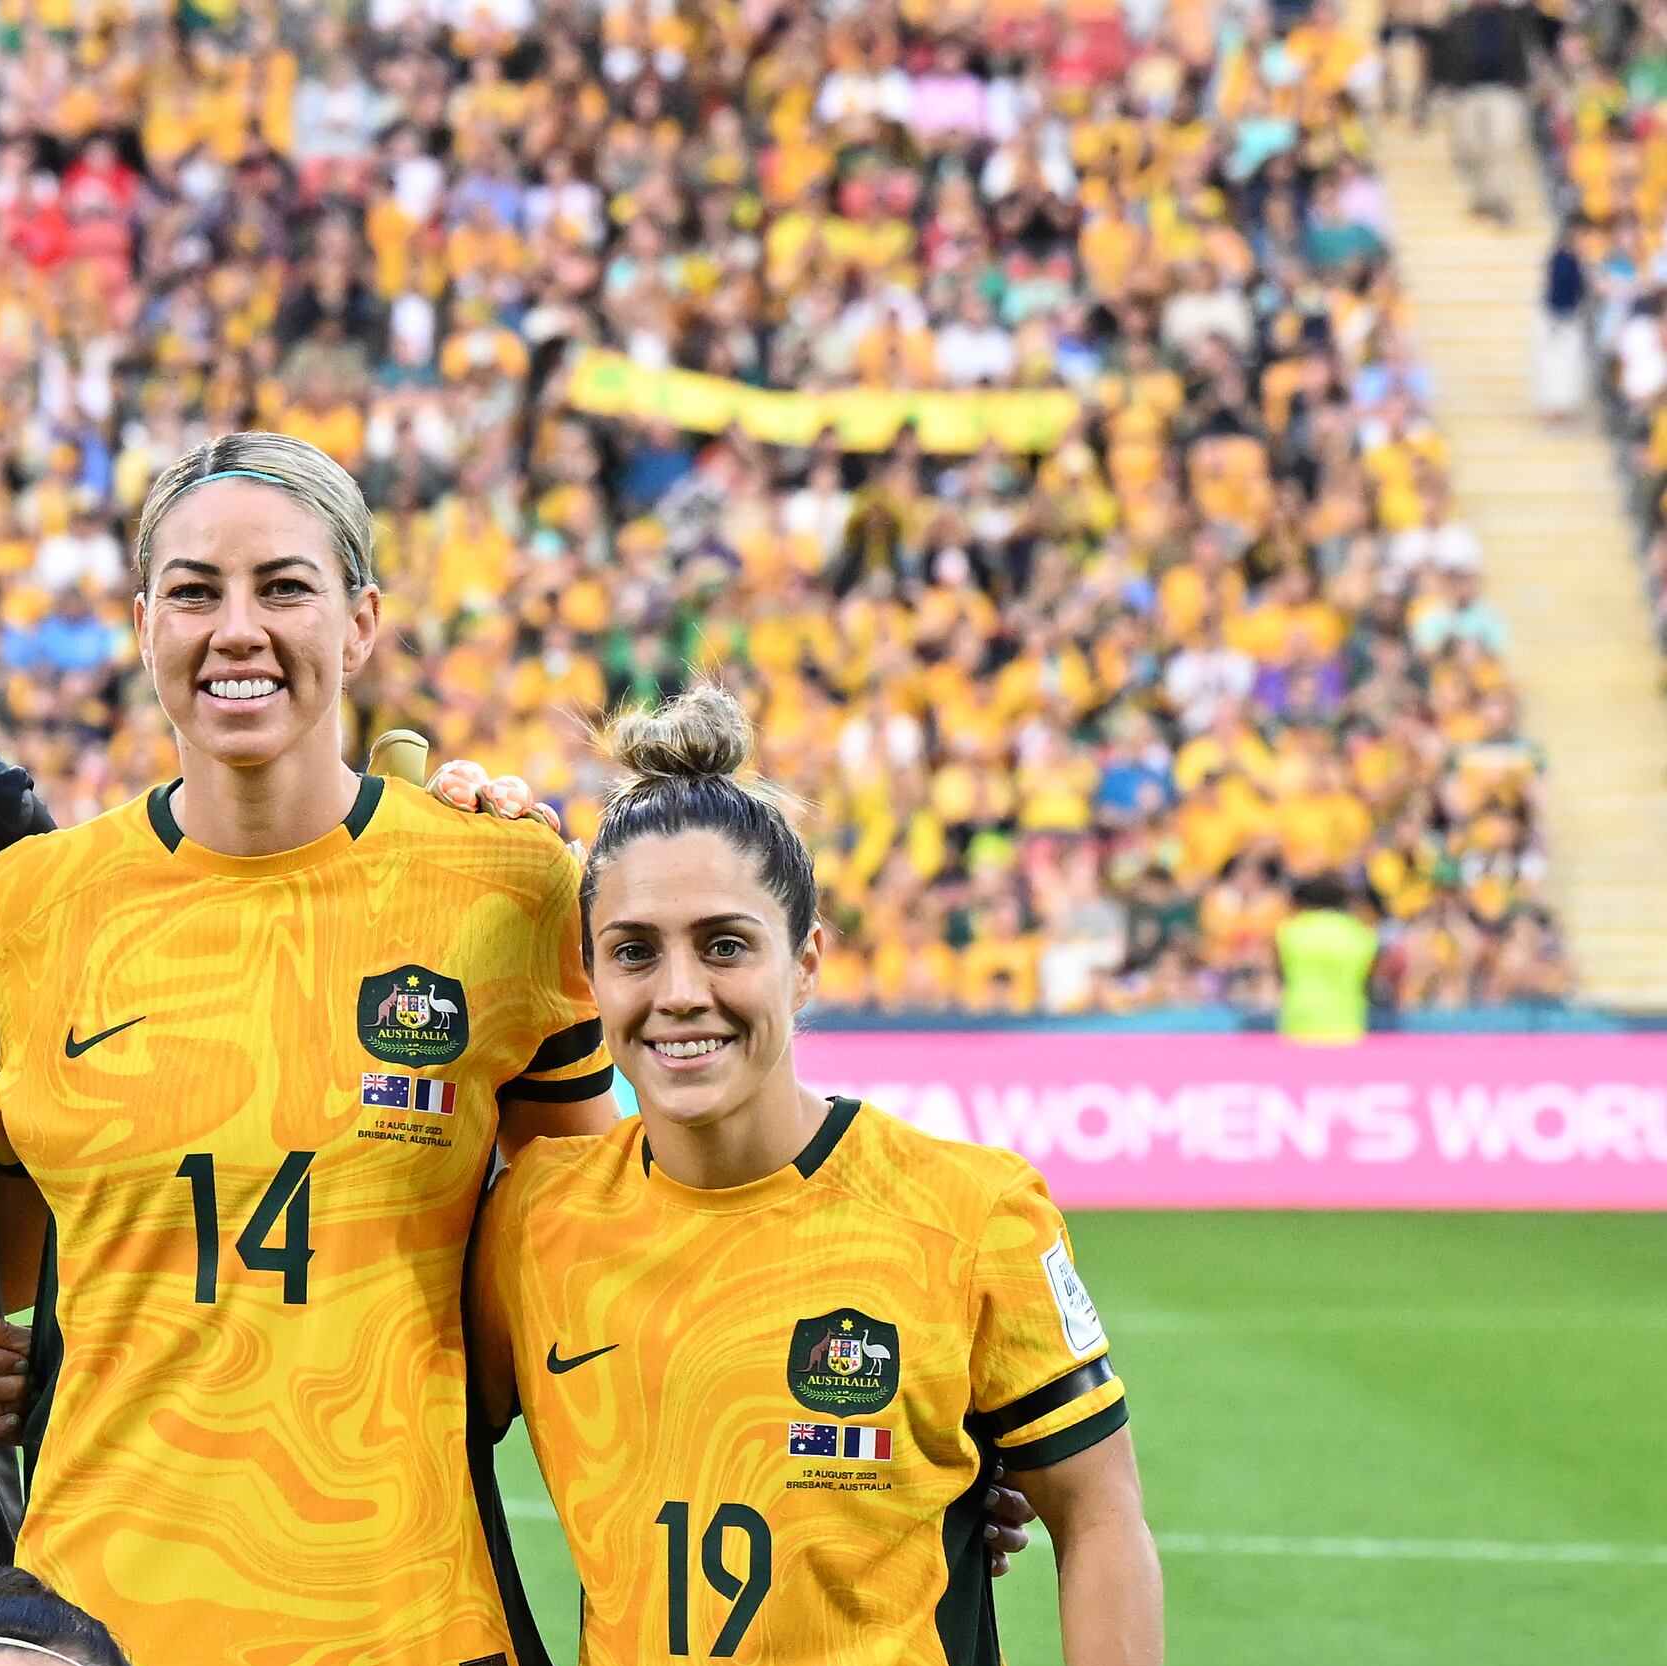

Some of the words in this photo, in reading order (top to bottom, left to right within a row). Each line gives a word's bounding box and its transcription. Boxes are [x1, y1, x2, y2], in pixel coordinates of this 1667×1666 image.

[378, 1028, 449, 1042] AUSTRALIA
[374, 1120, 385, 1128] 12
[387, 1121, 424, 1133] AUGUST
[425, 1126, 442, 1136] 2023
[970, 1083, 1420, 1162] WOMEN'S
[358, 1130, 407, 1143] BRISBANE,
[409, 1136, 452, 1148] AUSTRALIA
[175, 1150, 317, 1305] 14
[807, 1375, 880, 1388] AUSTRALIA
[802, 1470, 813, 1478] 12
[814, 1470, 853, 1480] AUGUST
[855, 1472, 877, 1480] 2023
[786, 1481, 837, 1491] BRISBANE,
[839, 1483, 892, 1491] AUSTRALIA
[654, 1500, 772, 1658] 19
